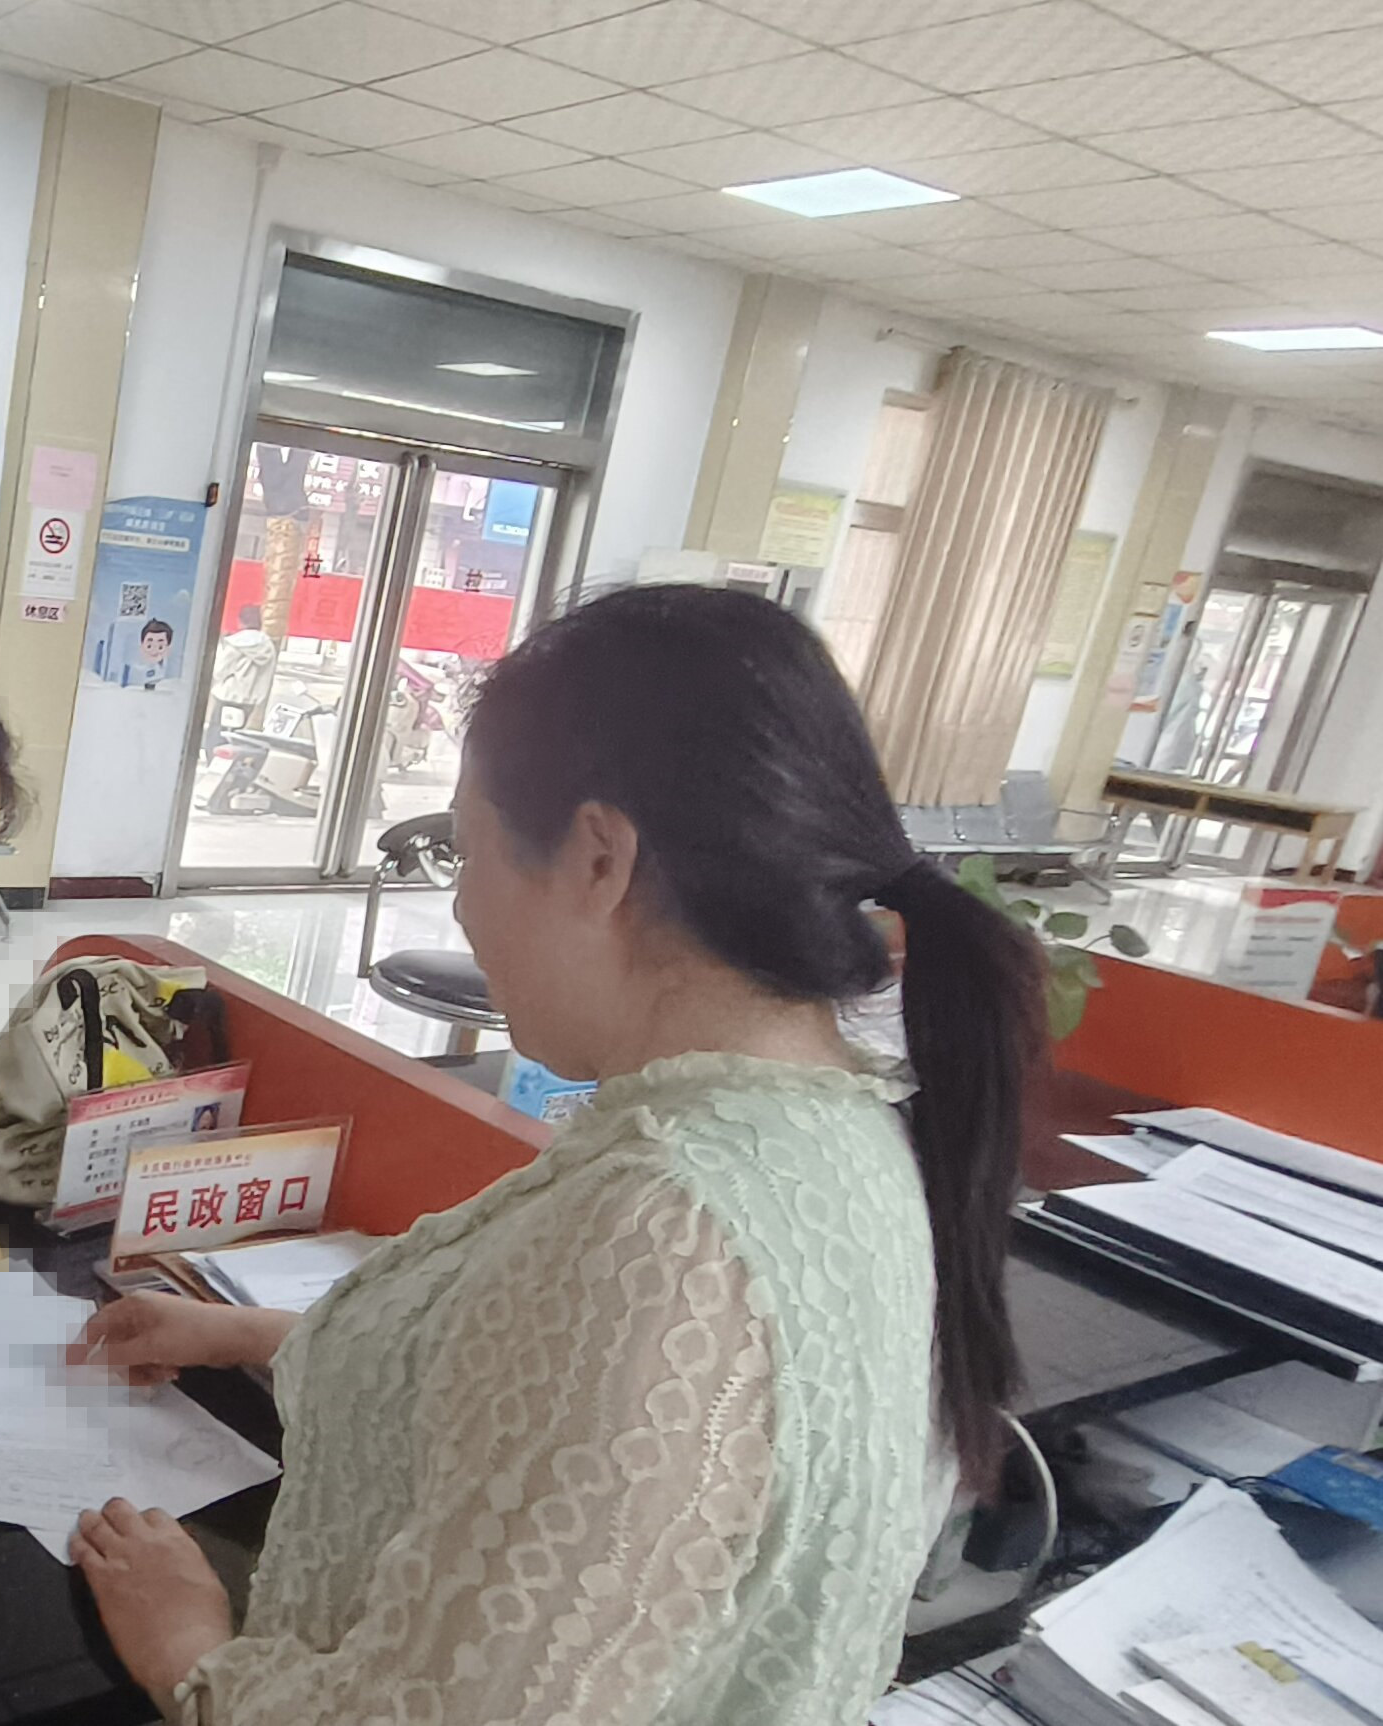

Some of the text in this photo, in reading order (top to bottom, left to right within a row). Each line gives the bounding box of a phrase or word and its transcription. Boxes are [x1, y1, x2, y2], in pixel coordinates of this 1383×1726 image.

[302, 553, 323, 579] 拉
[464, 568, 484, 592] 拉
[25, 604, 60, 621] 休息区
[142, 1176, 311, 1237] 民政窗口
